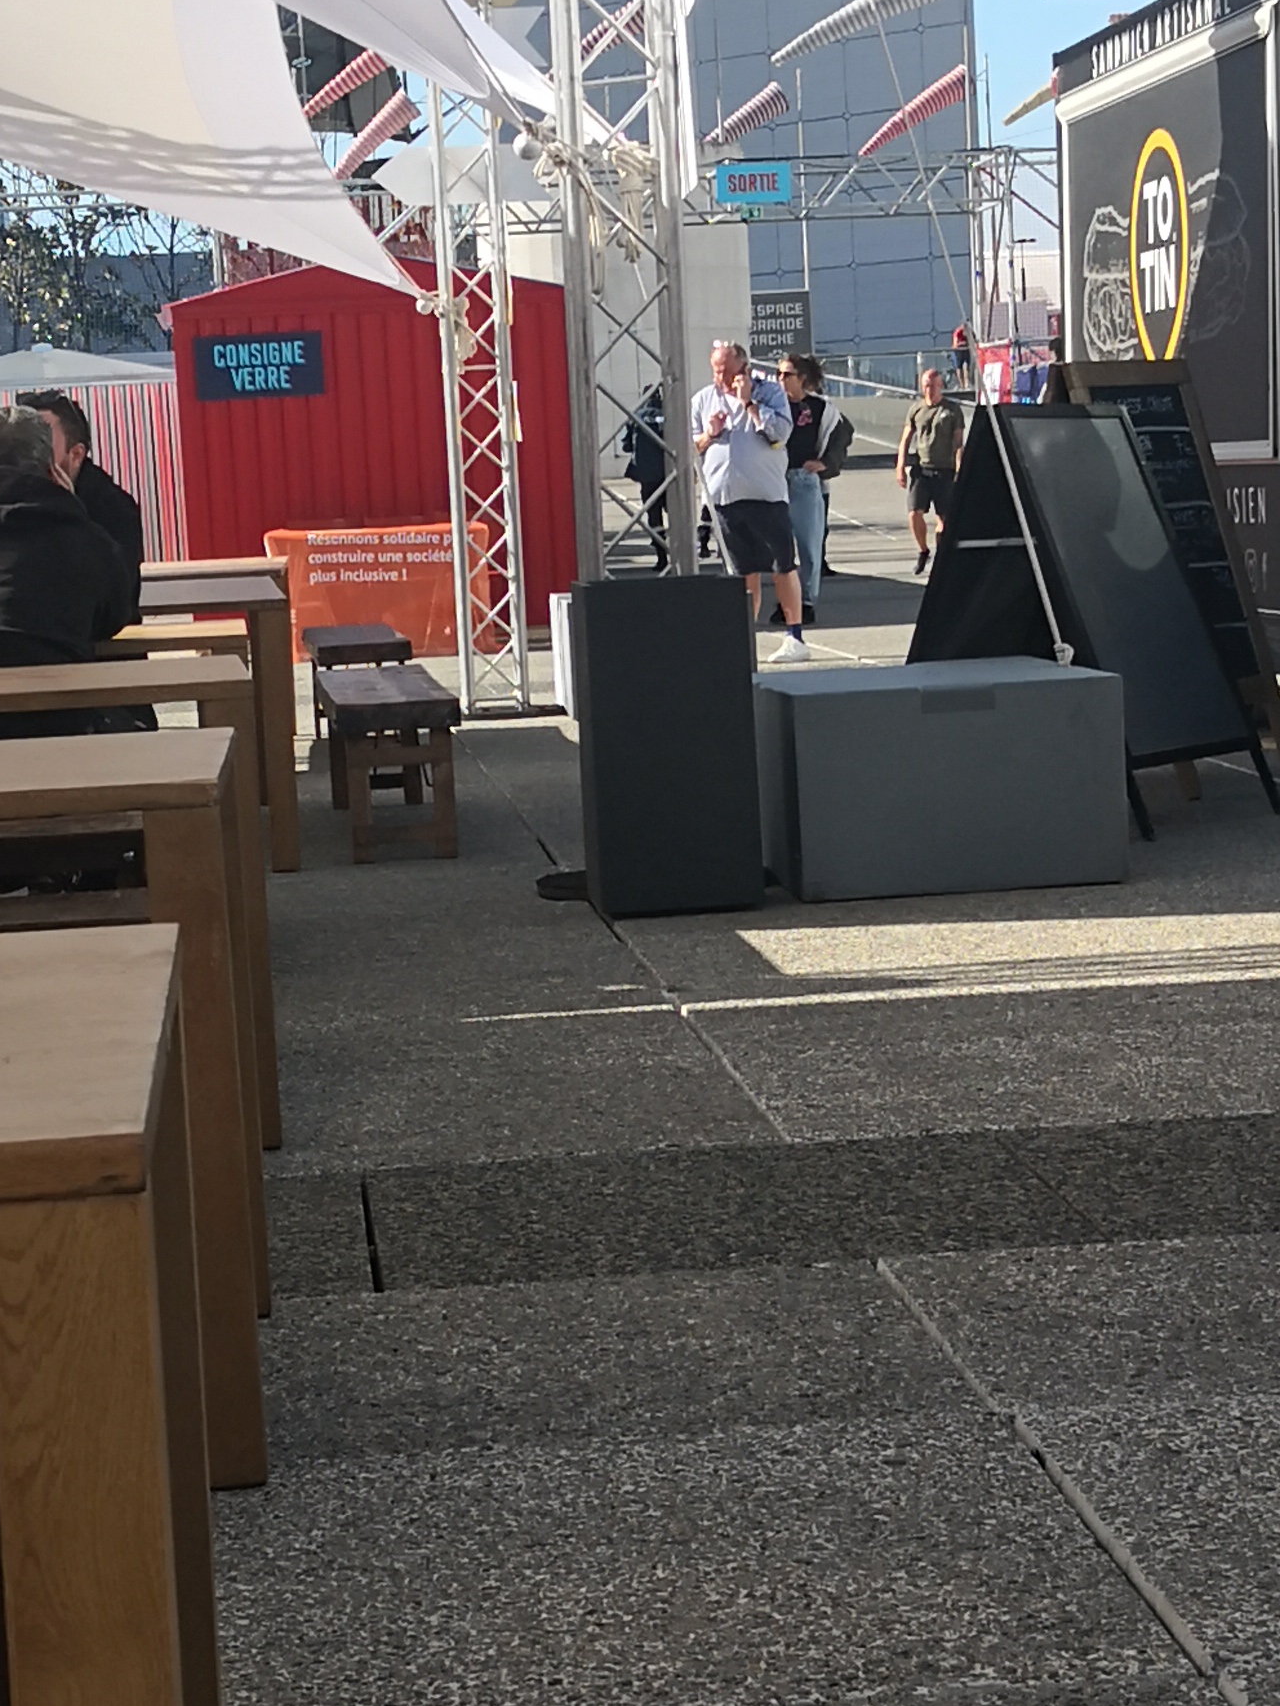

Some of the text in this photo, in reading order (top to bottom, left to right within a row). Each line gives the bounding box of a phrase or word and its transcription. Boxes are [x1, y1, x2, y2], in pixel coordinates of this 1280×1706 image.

[727, 172, 780, 194] SORTIE
[1142, 174, 1174, 245] TO
[1139, 244, 1177, 315] TIN
[750, 331, 796, 347] ARCHE
[213, 339, 306, 368] CONSIGNE
[230, 365, 293, 392] VERRE
[382, 531, 440, 545] solidaire
[443, 532, 474, 548] pr
[308, 549, 454, 565] construire une société
[308, 568, 408, 585] plus inclusive !
